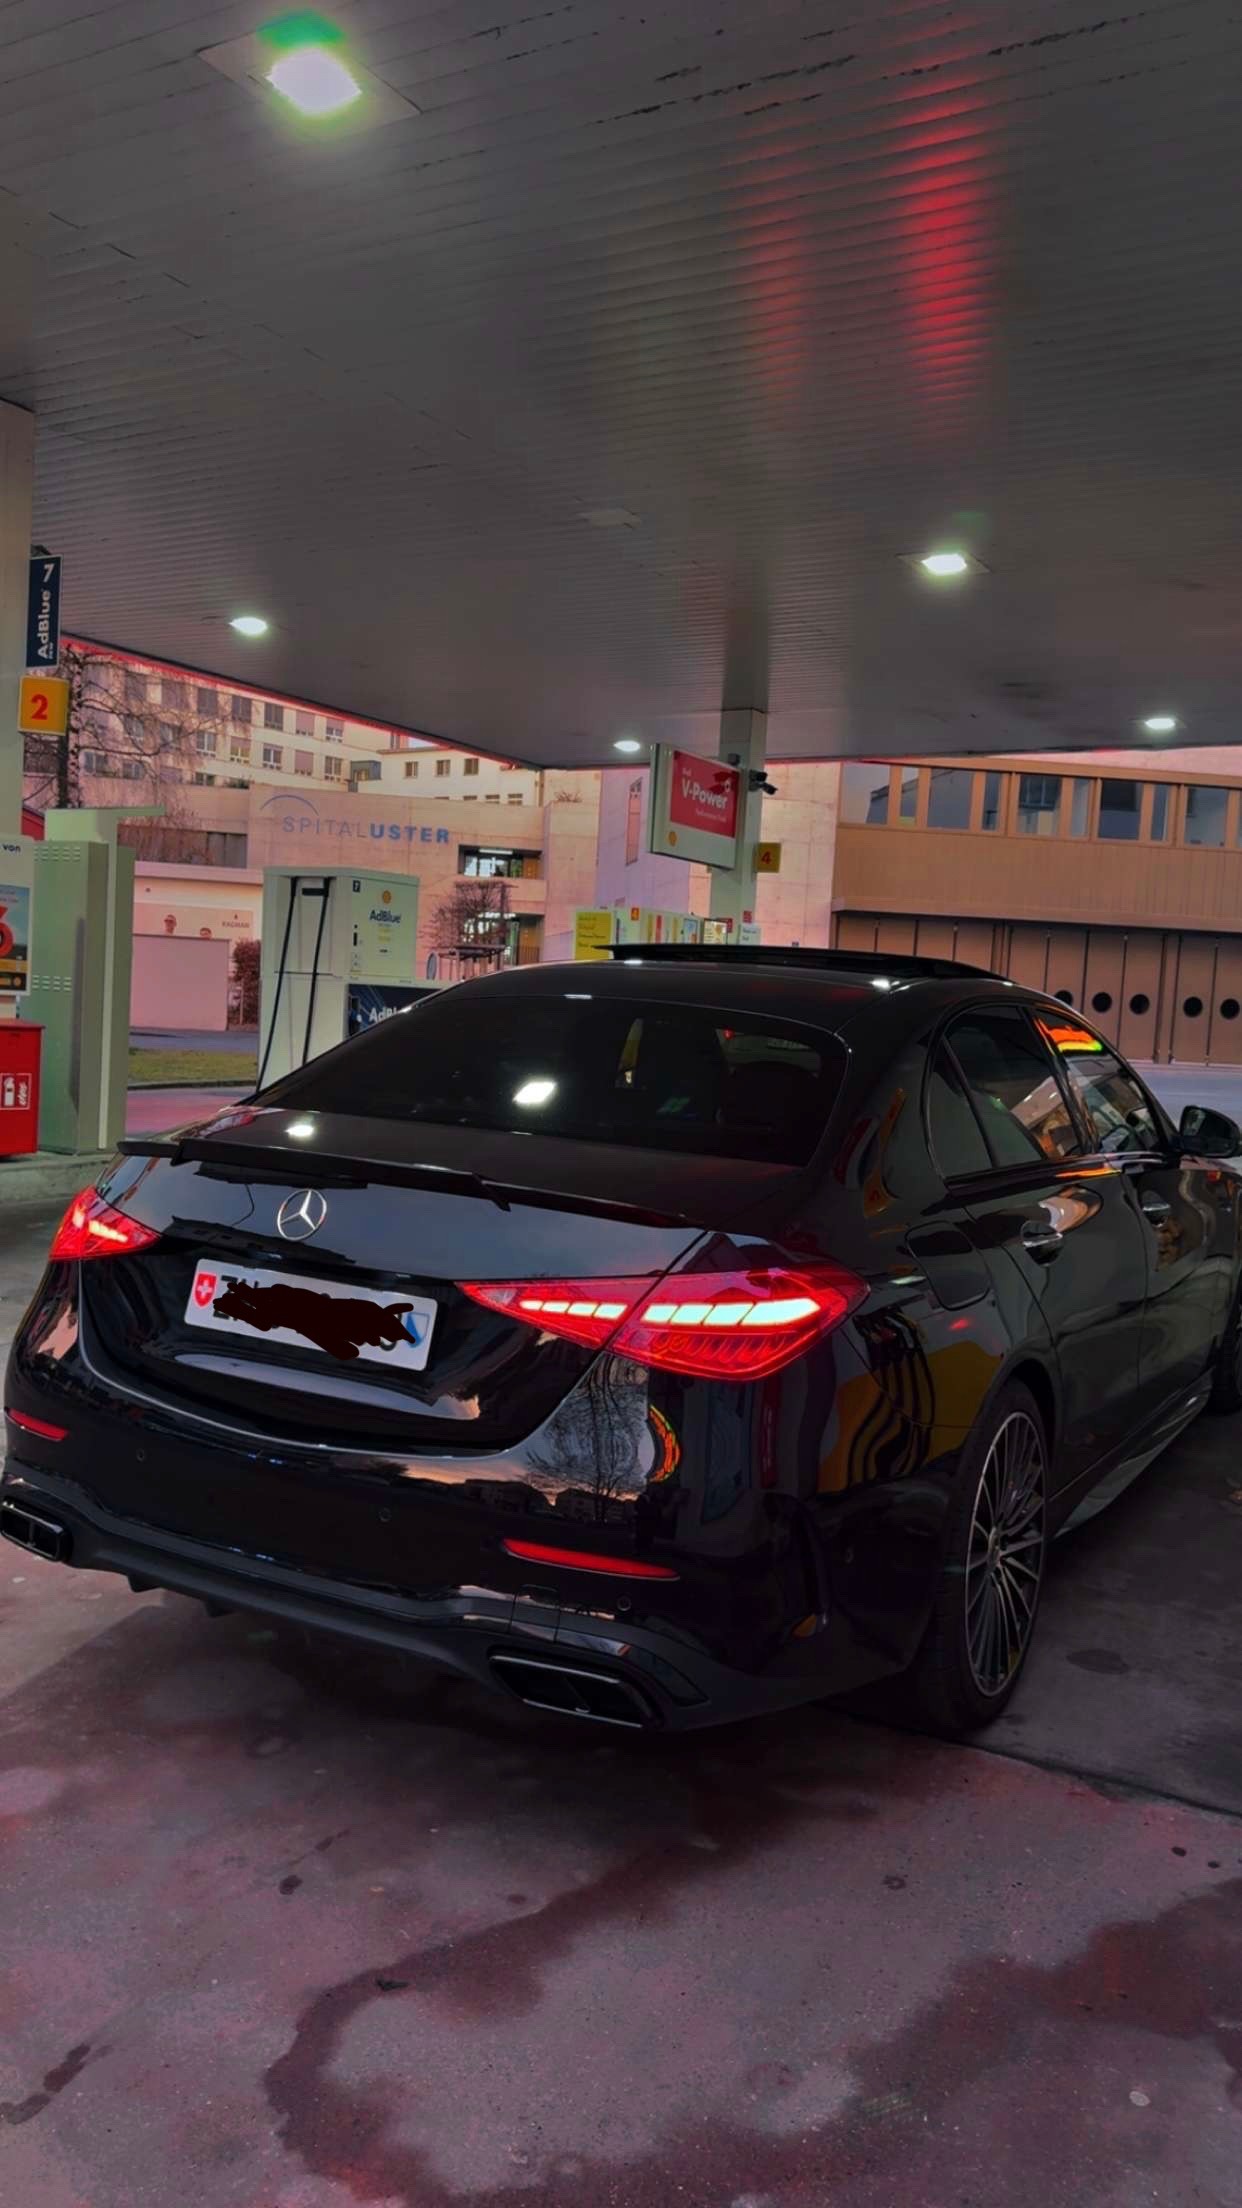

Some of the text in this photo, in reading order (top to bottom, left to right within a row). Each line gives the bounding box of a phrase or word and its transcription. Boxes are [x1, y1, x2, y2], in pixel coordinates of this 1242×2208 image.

[43, 563, 55, 583] 7
[37, 590, 51, 660] AdBlue
[31, 693, 49, 720] 2
[681, 777, 728, 809] V-Power
[761, 851, 772, 865] 4
[369, 909, 401, 924] AdBlue
